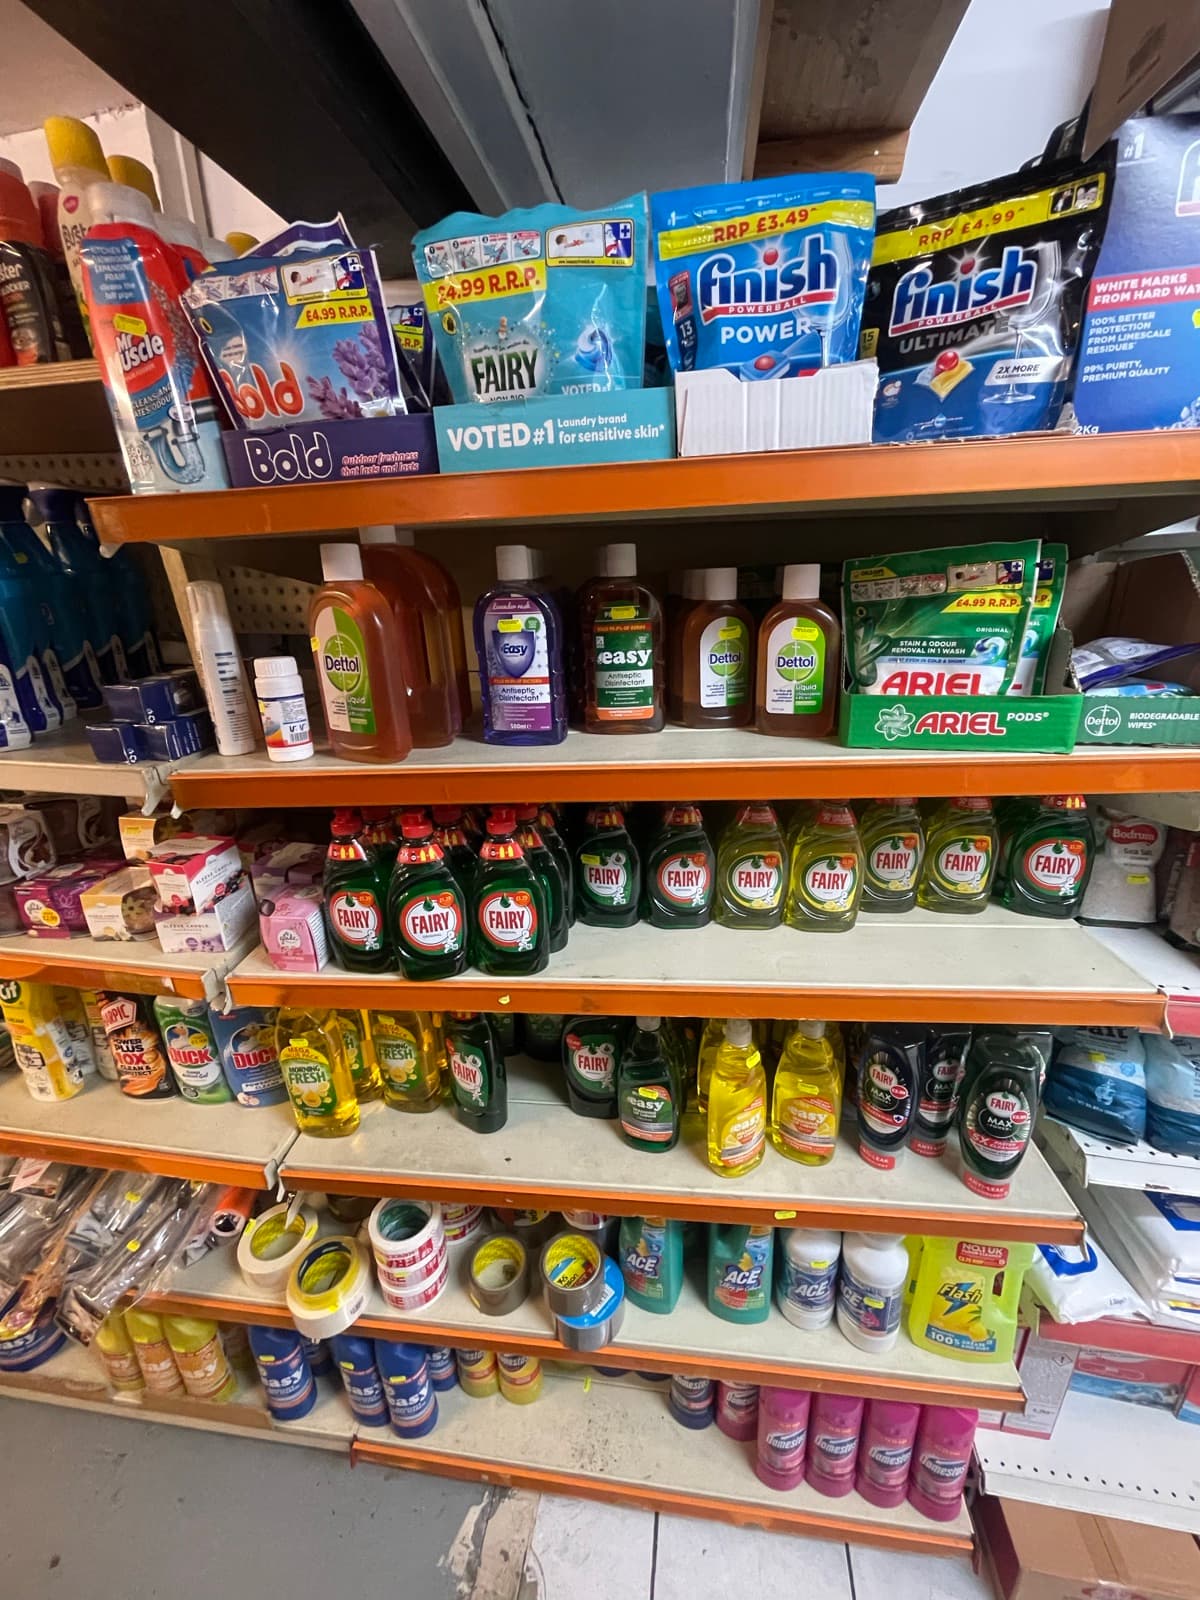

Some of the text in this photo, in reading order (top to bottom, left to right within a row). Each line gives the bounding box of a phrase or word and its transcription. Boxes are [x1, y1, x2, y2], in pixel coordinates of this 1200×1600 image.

[713, 221, 750, 243] RRP
[918, 227, 955, 248] RRP
[698, 233, 839, 307] finish
[437, 266, 541, 304] £4.99 R.R.P.
[892, 246, 1039, 325] finish
[1096, 273, 1188, 294] WHITE MARKS
[1093, 293, 1132, 306] FROM
[1133, 287, 1171, 301] HARD
[306, 304, 373, 323] £4.99 R.R.P.
[728, 297, 806, 315] POWERBALL
[918, 303, 998, 328] POWERBALL
[1091, 312, 1156, 327] 100% BETTER
[680, 319, 694, 336] 13
[720, 317, 813, 345] POWER
[900, 316, 1012, 354] ULTIMATE
[1089, 322, 1152, 337] PROTECTION
[116, 335, 133, 352] Mr
[861, 331, 875, 345] 15
[1088, 329, 1172, 346] FROM LIMESCALE
[471, 348, 539, 396] FAIRY
[997, 364, 1040, 374] 2X MORE
[1082, 366, 1171, 383] PREMIUM QUALITY
[1084, 360, 1142, 374] 99% PURITY,
[557, 413, 628, 430] Laundry brand
[447, 420, 555, 452] VOTED #1
[558, 430, 577, 444] for
[578, 425, 632, 443] sensitive
[244, 431, 334, 484] Bold
[342, 450, 419, 465] Outdoor freshness
[341, 461, 420, 477] that lasts and lasts
[956, 598, 1021, 608] £4.99 R.R.P.
[975, 626, 1009, 634] ORIGINAL
[503, 643, 528, 657] Easy
[601, 649, 653, 667] easy
[709, 652, 742, 665] Dettol
[892, 647, 921, 655] REMOVAL
[325, 654, 361, 673] Dettol
[777, 655, 815, 668] Dettol
[604, 679, 646, 687] Disinfectant
[607, 671, 642, 680] Antiseptic
[881, 671, 983, 696] ARIEL
[499, 694, 540, 702] Disinfectant
[501, 687, 536, 696] Antiseptic
[915, 712, 1006, 735] ARIEL
[1087, 716, 1119, 726] Dettol
[1129, 712, 1200, 721] BIODEGRADABLE
[1112, 828, 1155, 841] Bodrum
[876, 852, 911, 870] FAIRY
[944, 853, 982, 872] FAIRY
[1034, 855, 1075, 875] FAIRY
[588, 867, 621, 885] FAIRY
[667, 870, 702, 887] FAIRY
[738, 871, 773, 888] FAIRY
[811, 872, 848, 890] FAIRY
[336, 908, 370, 929] FAIRY
[411, 911, 450, 934] FAIRY
[488, 910, 526, 929] FAIRY
[116, 1043, 145, 1052] PLUS
[169, 1047, 214, 1065] DUCK
[380, 1048, 413, 1060] FRESH
[578, 1054, 609, 1072] FAIRY
[288, 1071, 326, 1085] FRESH
[453, 1060, 478, 1084] FAIRY
[872, 1068, 894, 1086] FAIRY
[870, 1087, 892, 1101] MAX
[629, 1098, 665, 1112] easy
[990, 1097, 1017, 1112] FAIRY
[788, 1105, 828, 1124] easy
[987, 1116, 1013, 1128] MAX
[972, 1132, 989, 1145] 5X
[987, 1246, 1004, 1256] UK
[627, 1255, 658, 1271] ACE
[726, 1269, 762, 1286] ACE
[797, 1280, 829, 1298] ACE
[940, 1283, 983, 1305] Flash
[919, 1453, 967, 1478] Domestos
